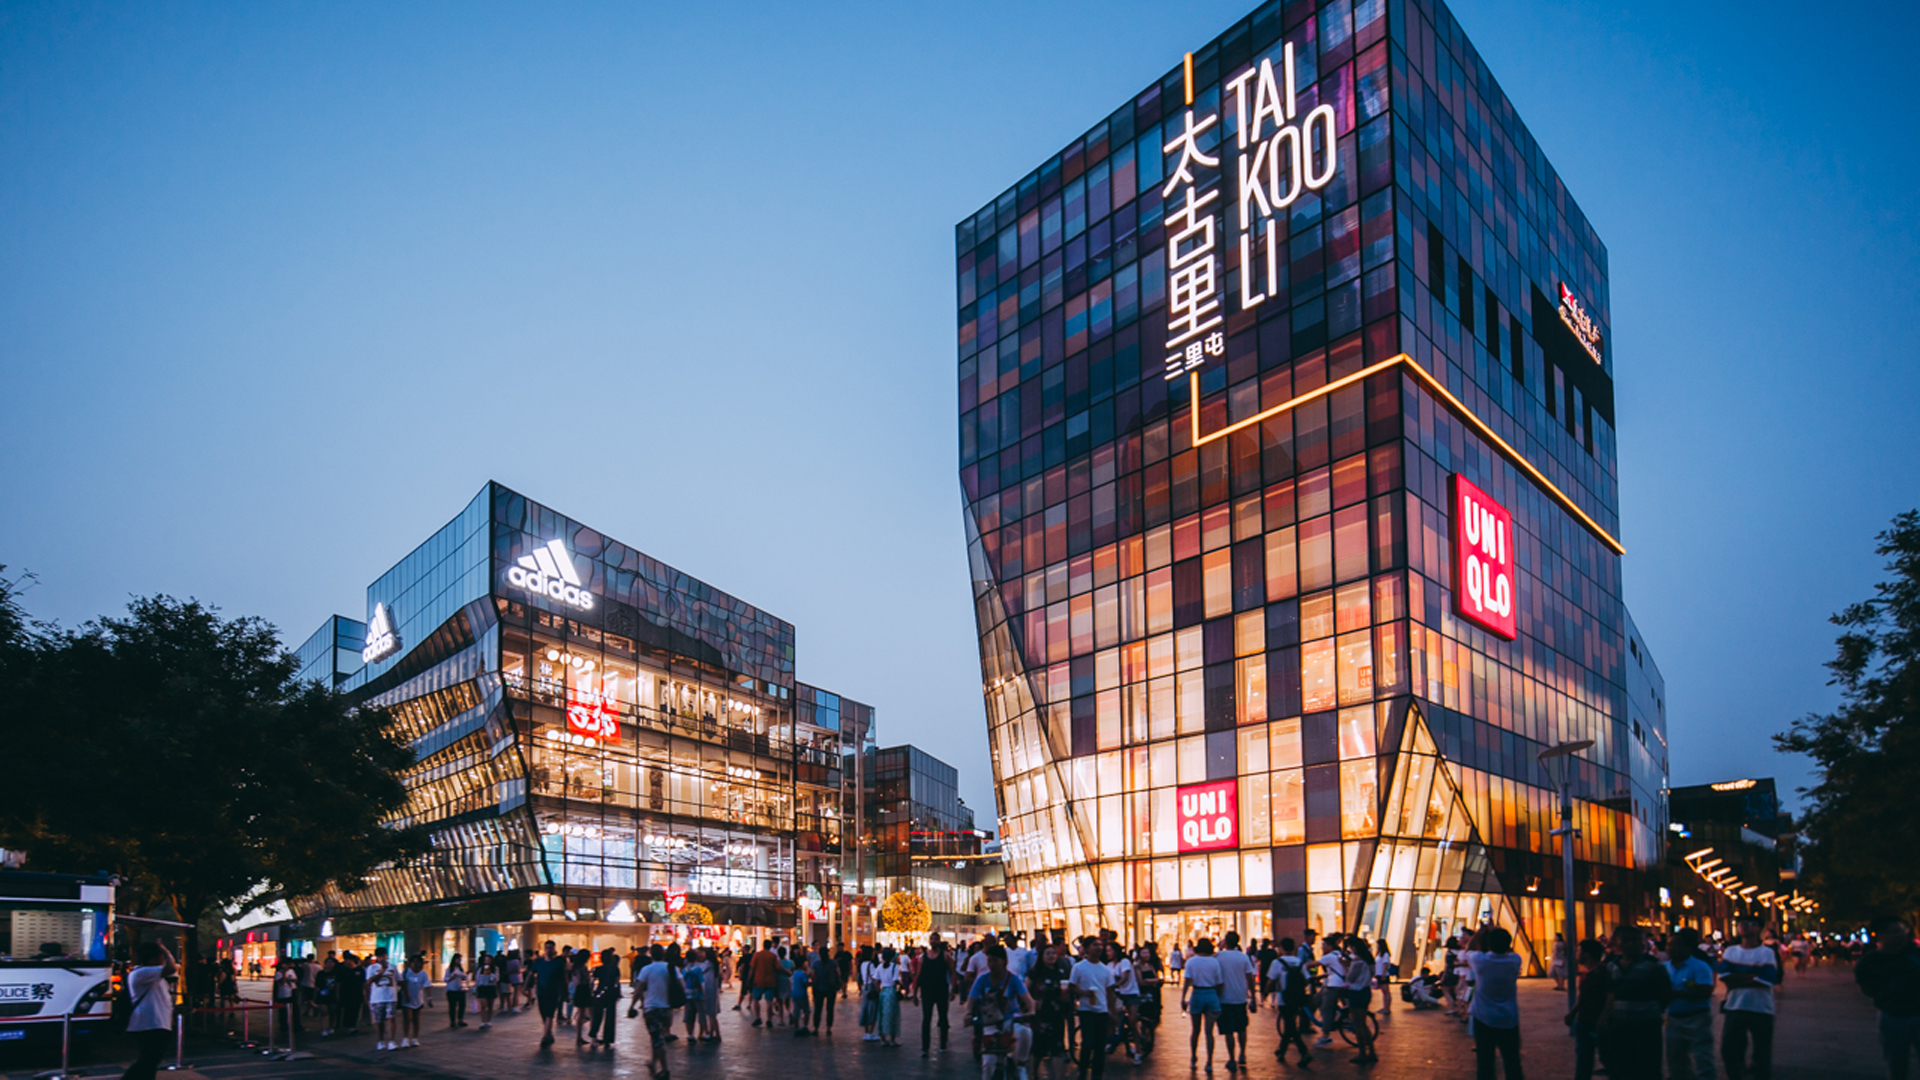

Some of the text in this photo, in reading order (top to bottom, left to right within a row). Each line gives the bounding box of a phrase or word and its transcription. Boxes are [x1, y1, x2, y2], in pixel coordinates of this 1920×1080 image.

[1226, 41, 1296, 149] TAI
[1238, 104, 1336, 230] KOO
[1162, 110, 1222, 348] 太古里
[1240, 219, 1277, 310] LI
[1164, 332, 1225, 381] 三里屯
[1464, 495, 1506, 565] UNI
[507, 564, 594, 611] adidas
[1467, 554, 1511, 618] QLO
[1360, 668, 1372, 677] UN
[1360, 676, 1372, 686] QL
[1182, 789, 1227, 817] UNI
[1183, 816, 1232, 847] QLO
[0, 987, 29, 998] OLICE
[31, 983, 54, 1000] 察
